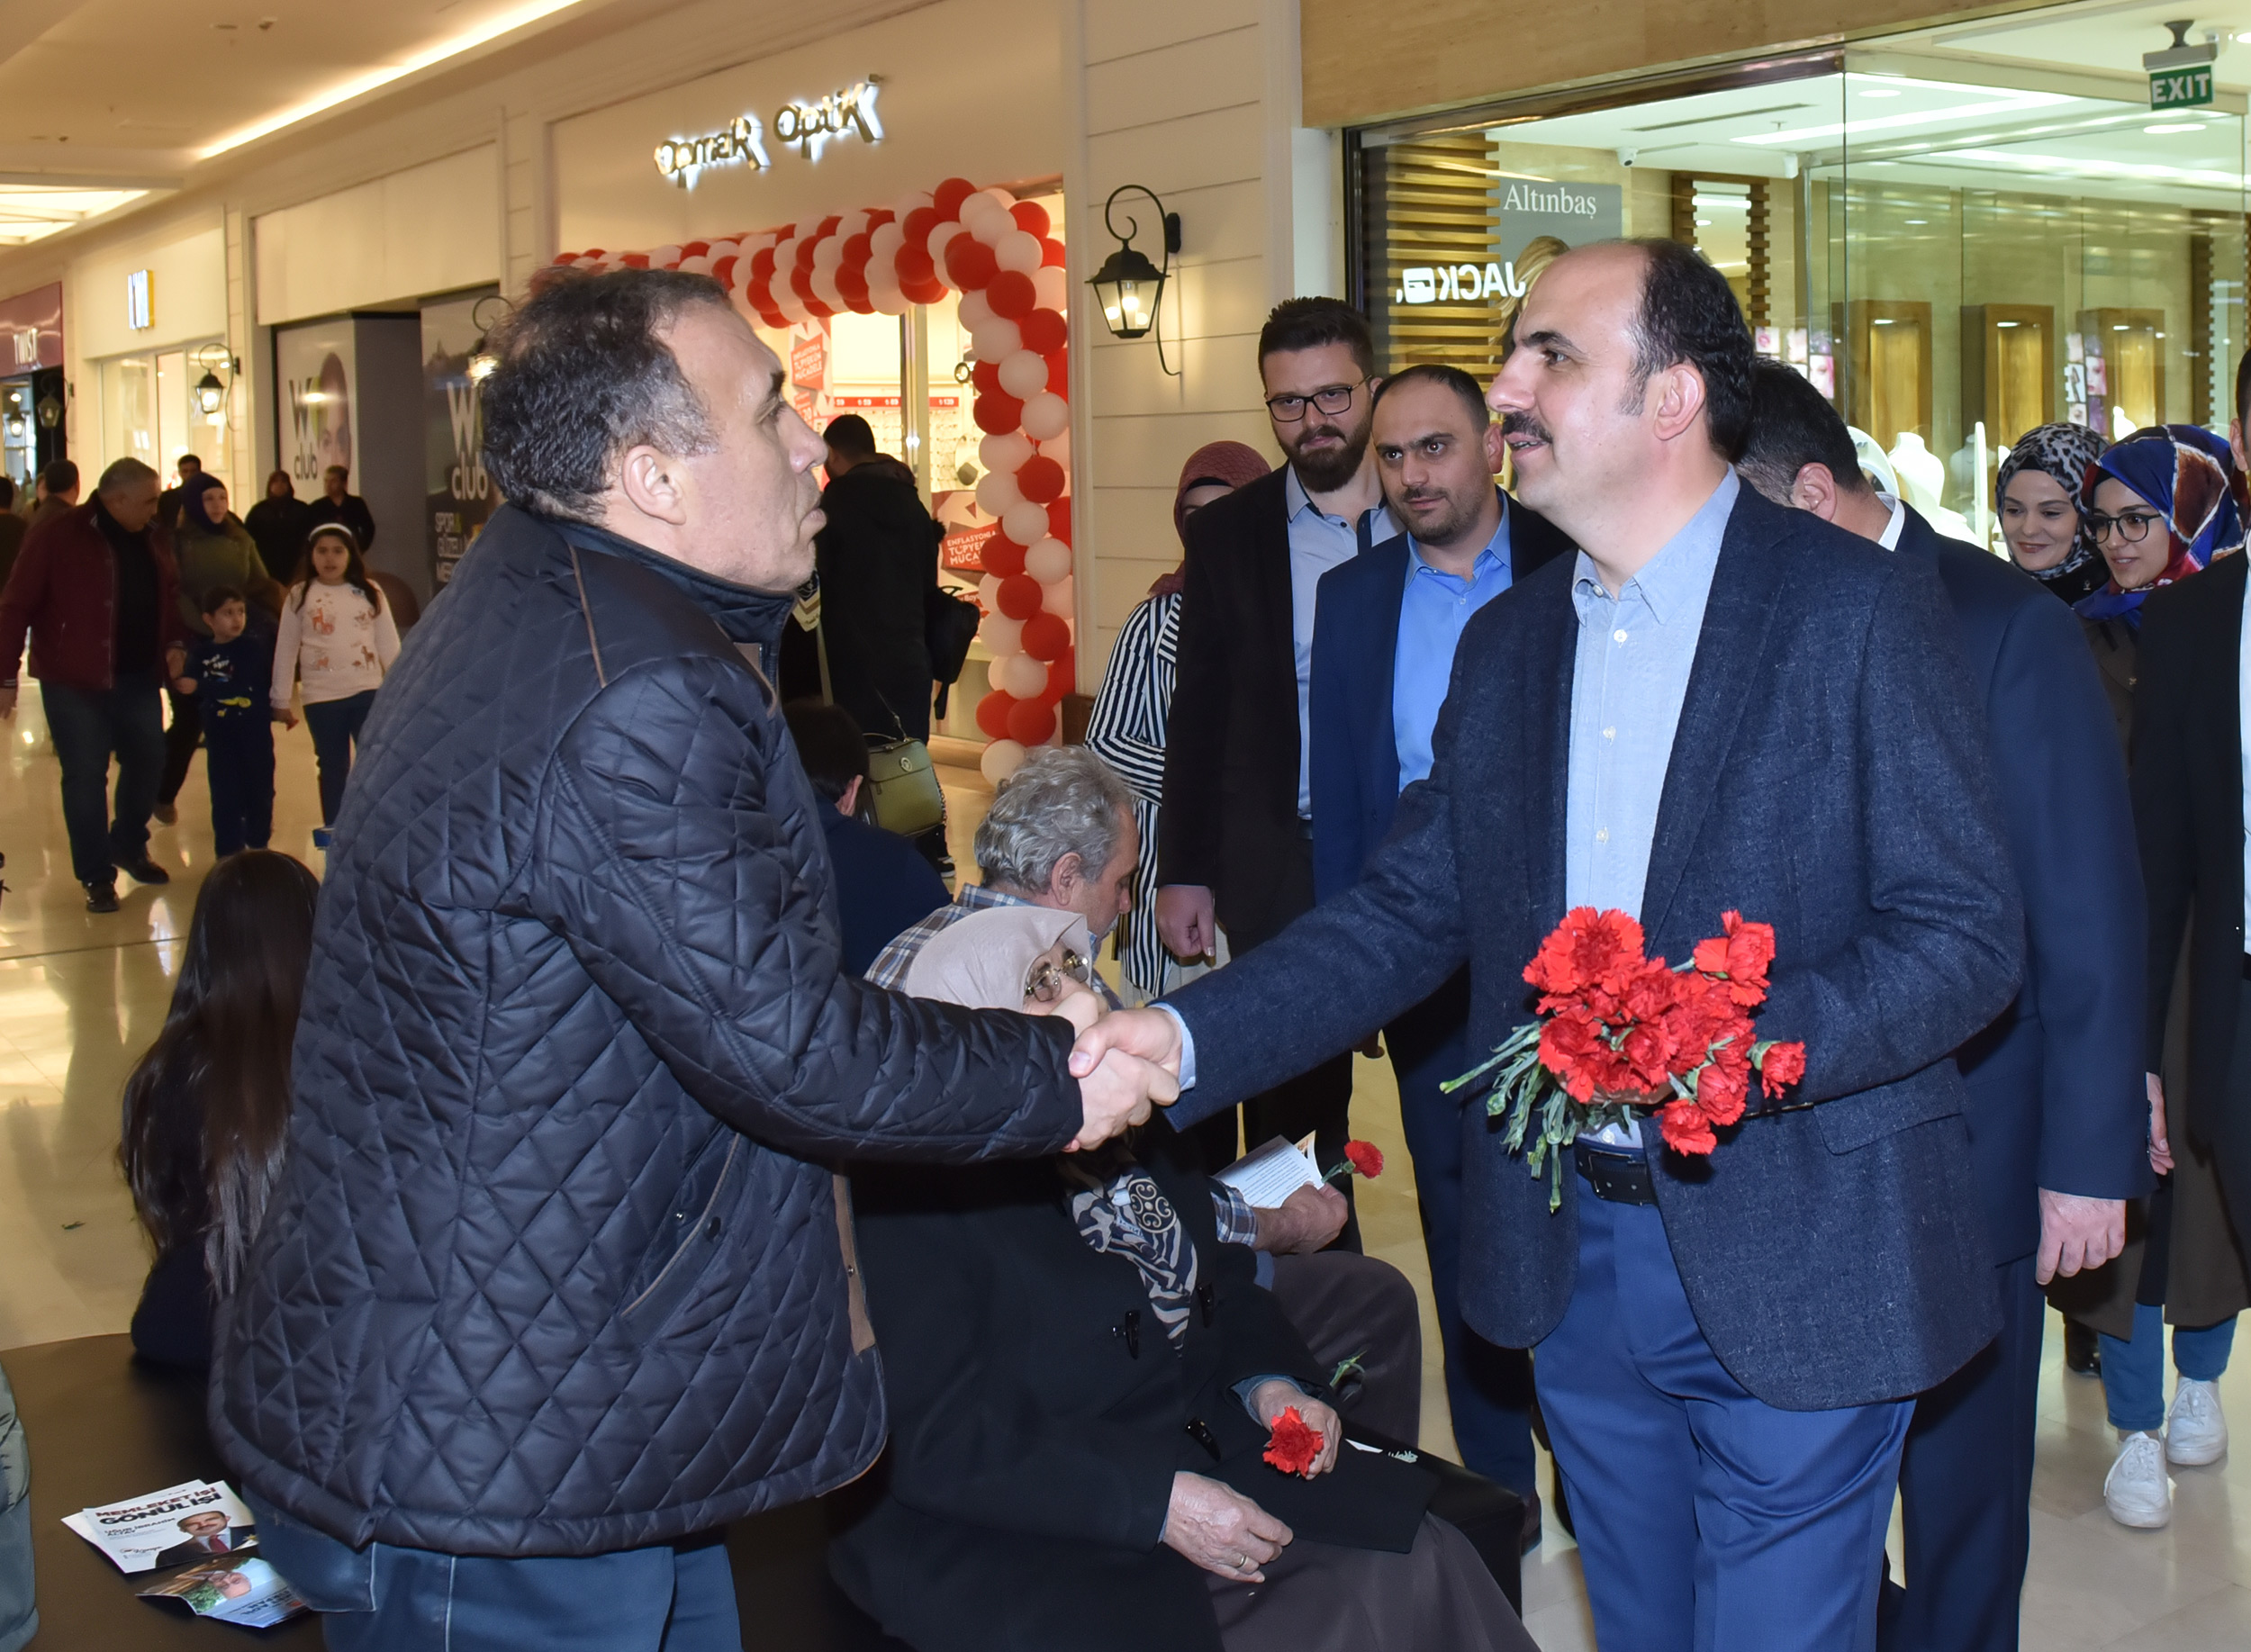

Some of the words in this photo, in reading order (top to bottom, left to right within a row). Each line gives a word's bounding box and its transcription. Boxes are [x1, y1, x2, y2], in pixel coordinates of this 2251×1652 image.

[2151, 73, 2210, 104] EXIT
[294, 442, 318, 480] club
[452, 451, 489, 501] club
